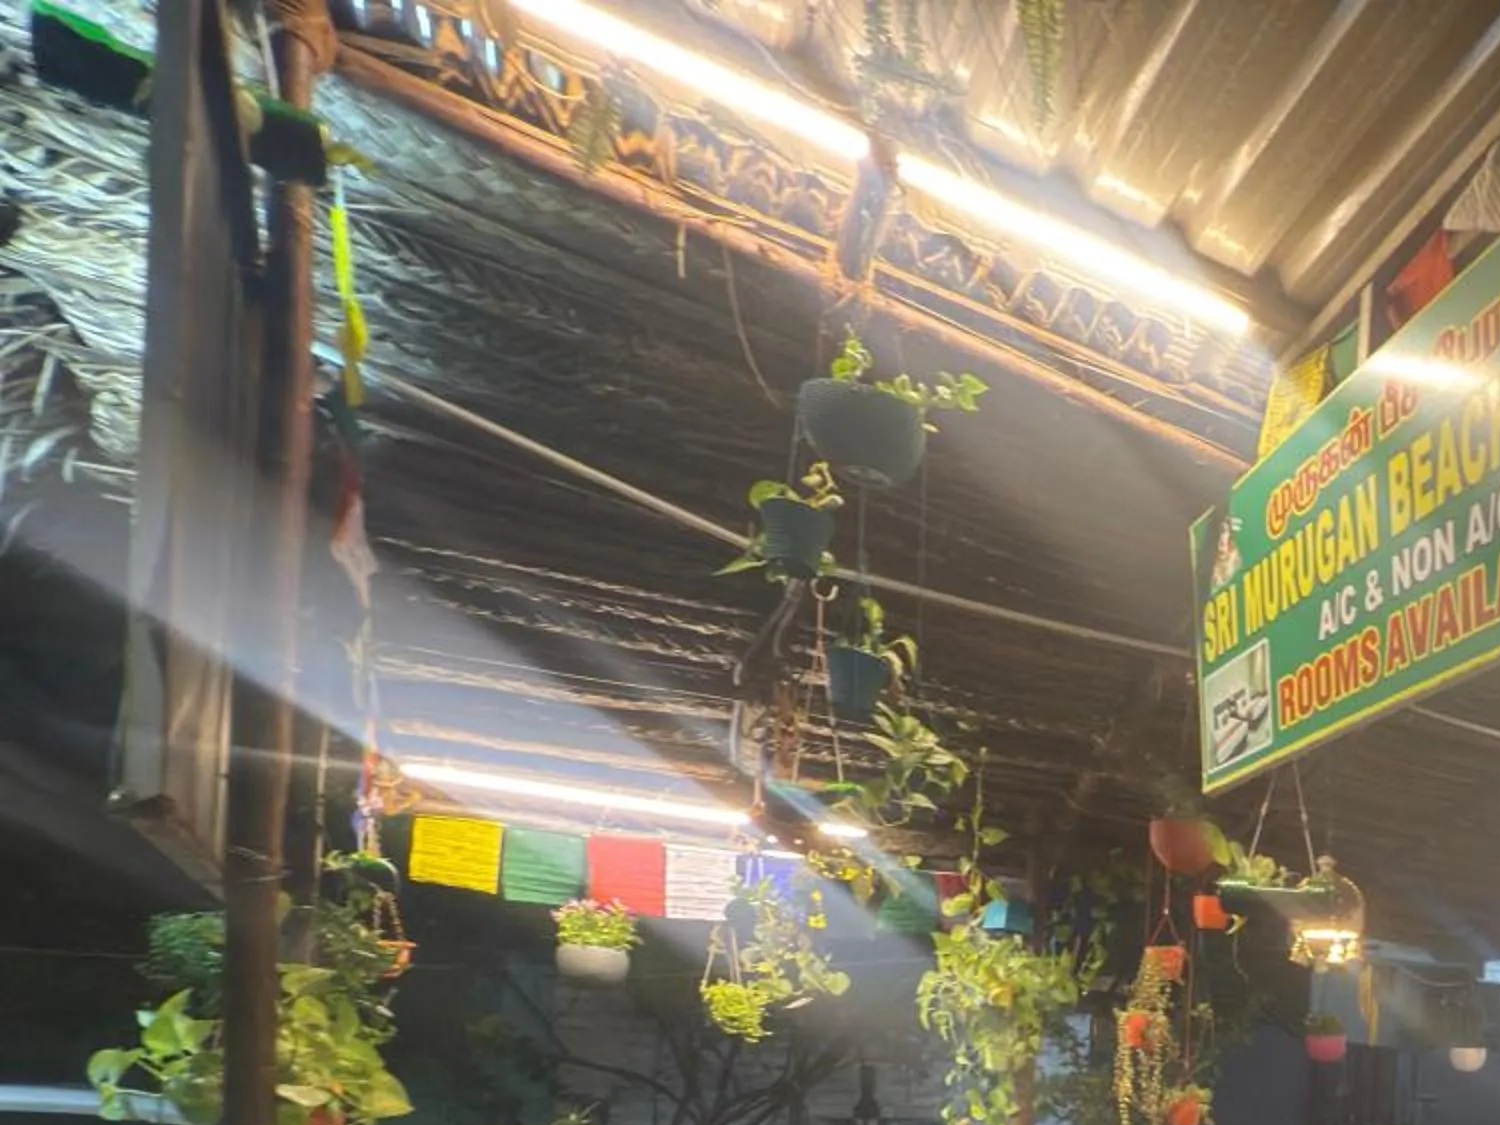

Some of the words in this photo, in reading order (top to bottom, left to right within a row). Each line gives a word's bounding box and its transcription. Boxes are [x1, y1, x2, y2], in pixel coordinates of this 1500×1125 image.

[1205, 584, 1238, 662] SRI
[1243, 474, 1378, 636] MURUGAN
[1318, 584, 1358, 640] A/C
[1364, 569, 1383, 611] &
[1392, 520, 1456, 595] NON
[1277, 625, 1380, 730] ROOMS
